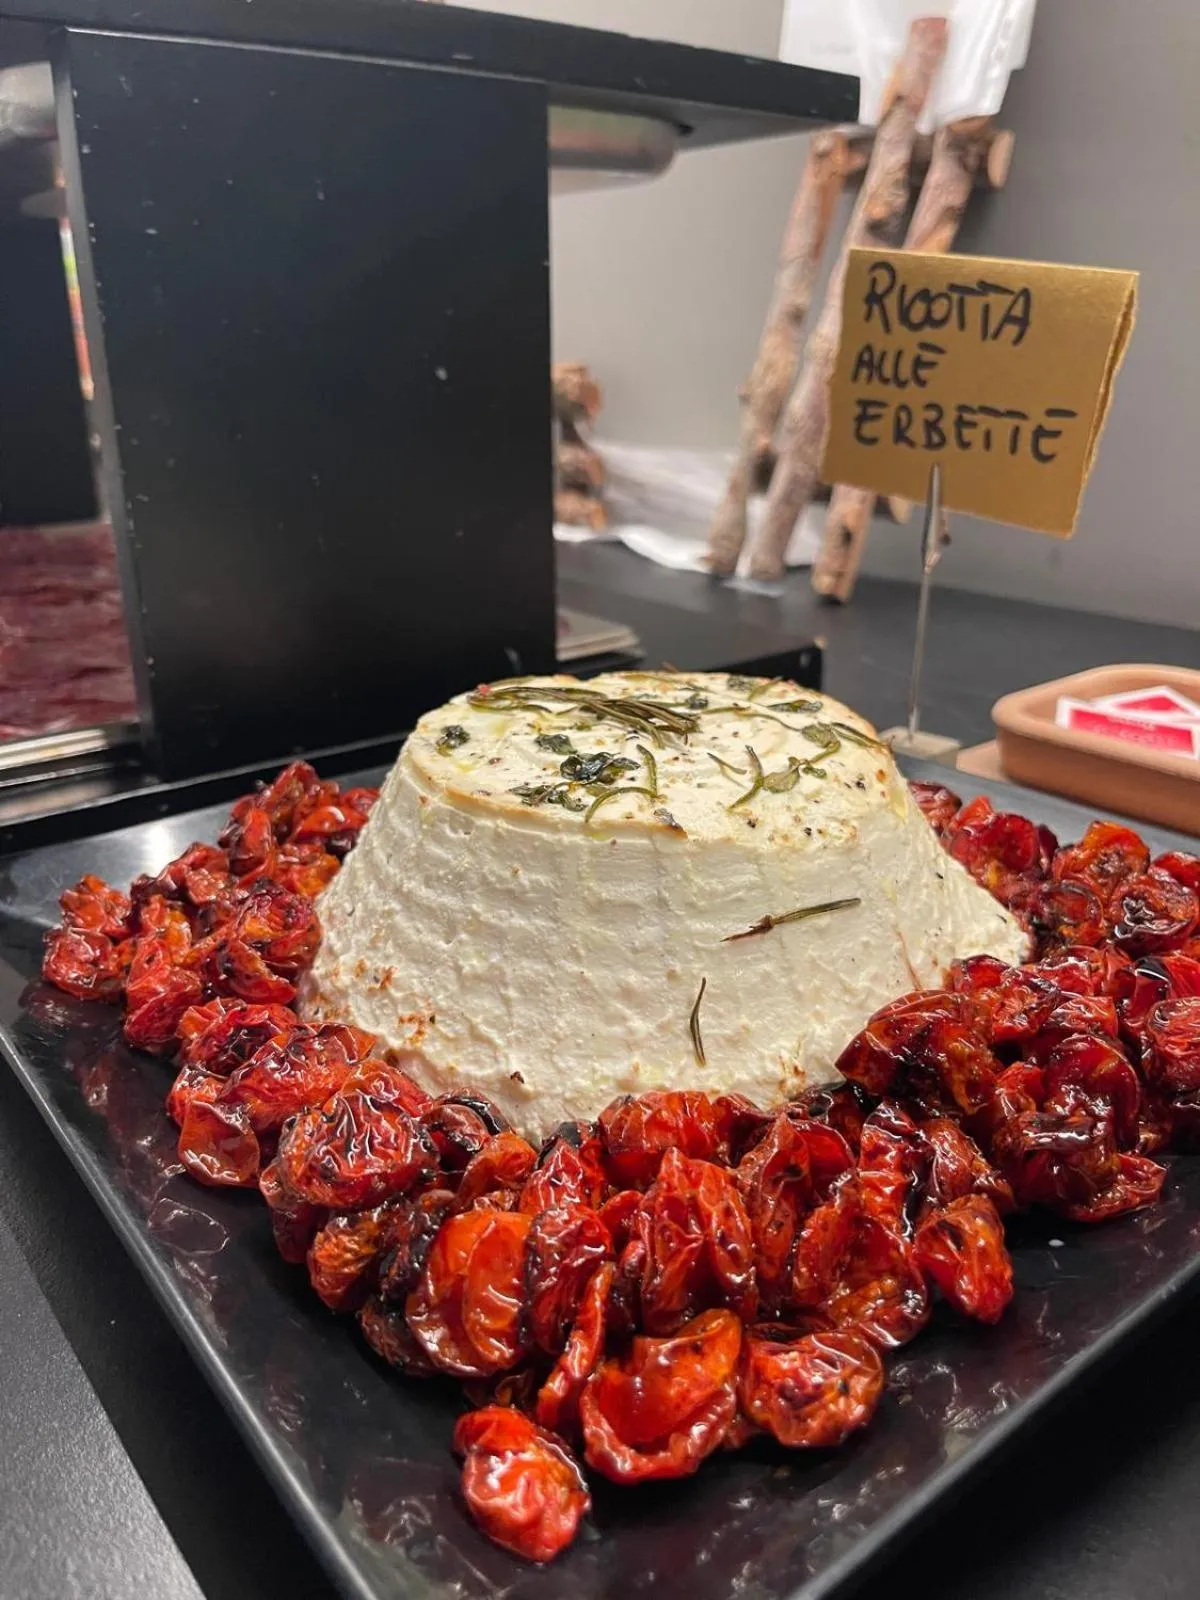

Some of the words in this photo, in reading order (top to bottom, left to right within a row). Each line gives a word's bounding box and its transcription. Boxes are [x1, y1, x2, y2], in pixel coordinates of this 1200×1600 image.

[864, 261, 1031, 346] RICOTTA
[852, 342, 947, 388] ALLE
[853, 399, 1078, 463] ERBETTE
